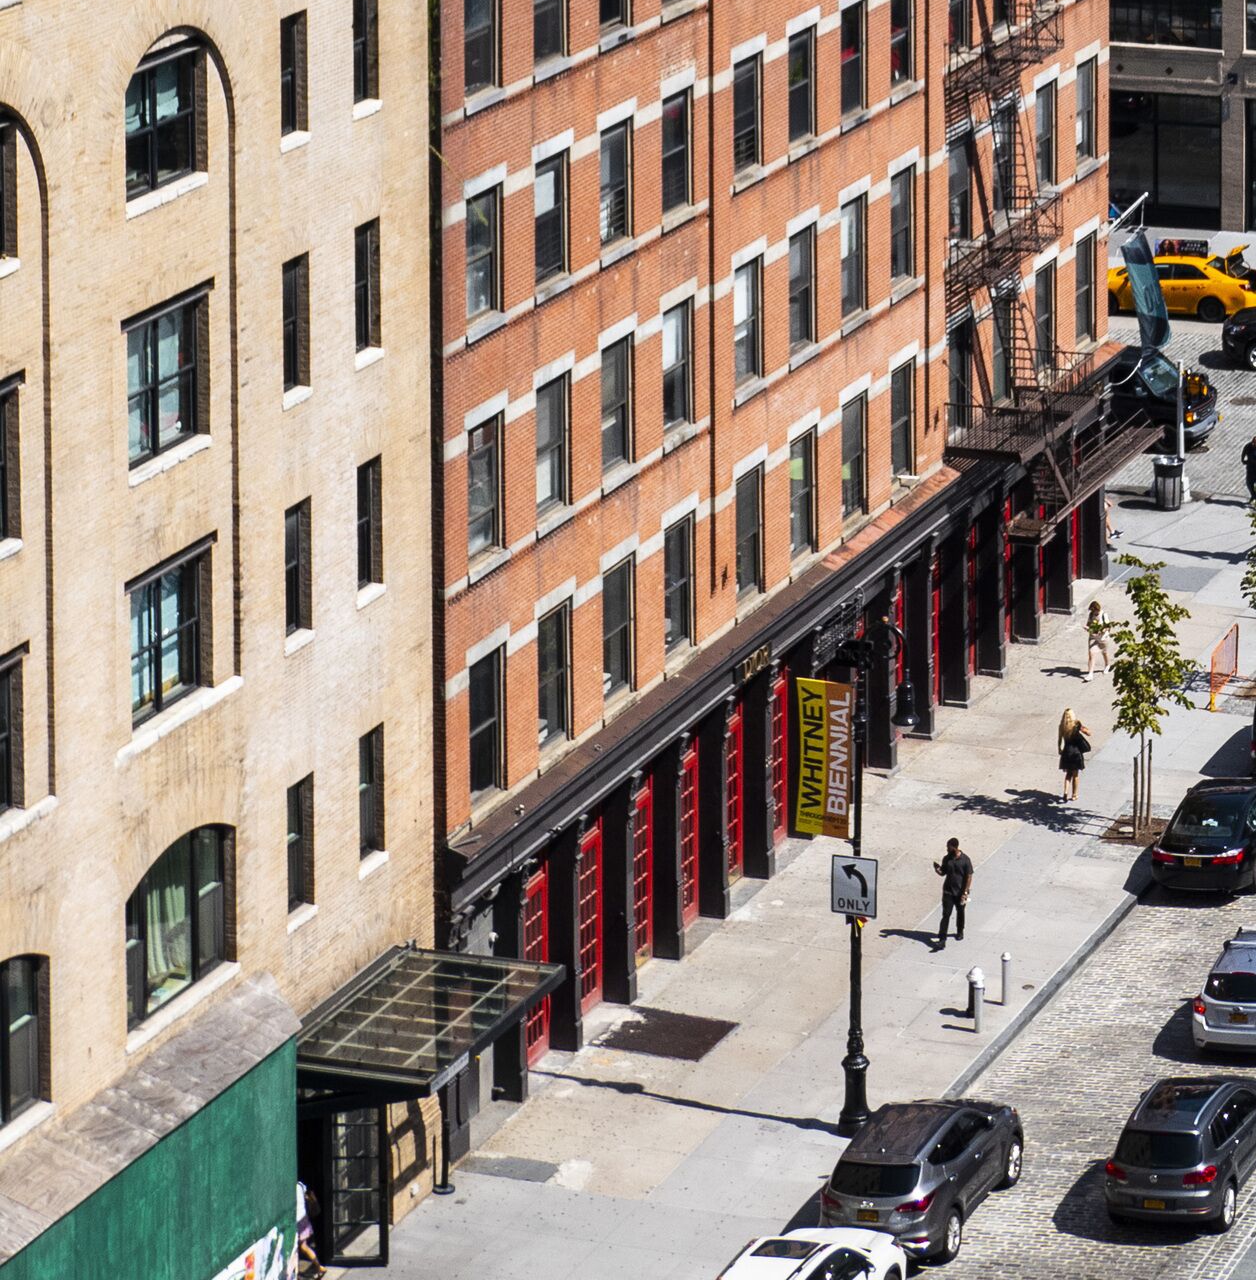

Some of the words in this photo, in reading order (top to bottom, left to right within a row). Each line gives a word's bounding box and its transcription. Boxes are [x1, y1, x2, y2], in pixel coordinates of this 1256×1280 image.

[742, 644, 771, 681] DIOR
[800, 686, 825, 810] WHITNEY
[827, 691, 852, 817] BIENNIAL
[837, 897, 871, 913] ONLY
